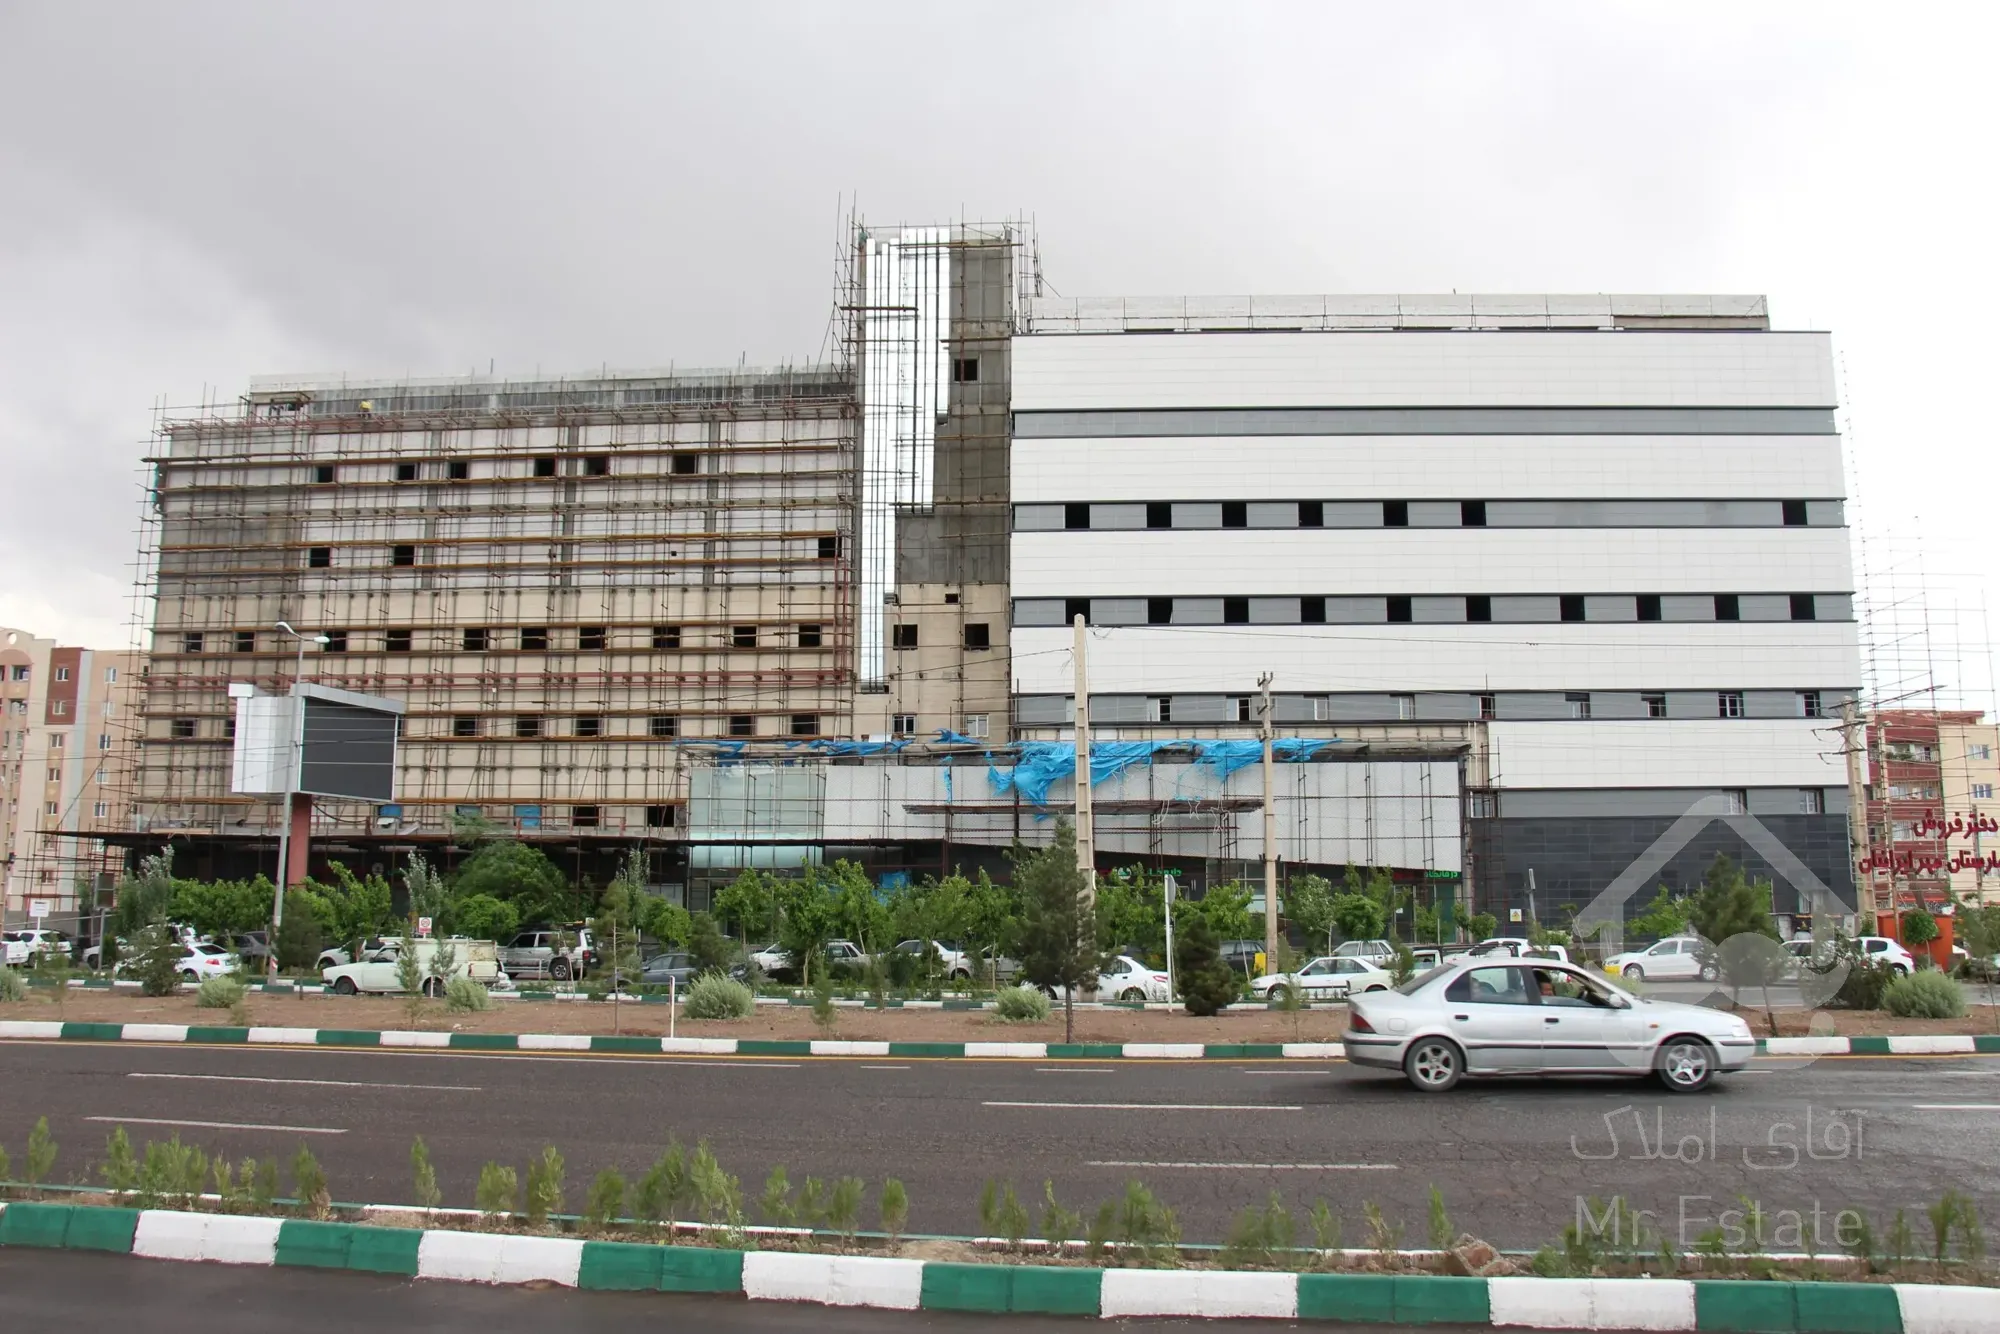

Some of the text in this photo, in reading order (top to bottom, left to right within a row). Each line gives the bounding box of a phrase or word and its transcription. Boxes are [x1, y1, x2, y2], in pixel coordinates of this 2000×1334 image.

[1913, 808, 1998, 839] دفتر فروش
[1947, 850, 2000, 874] ارستان
